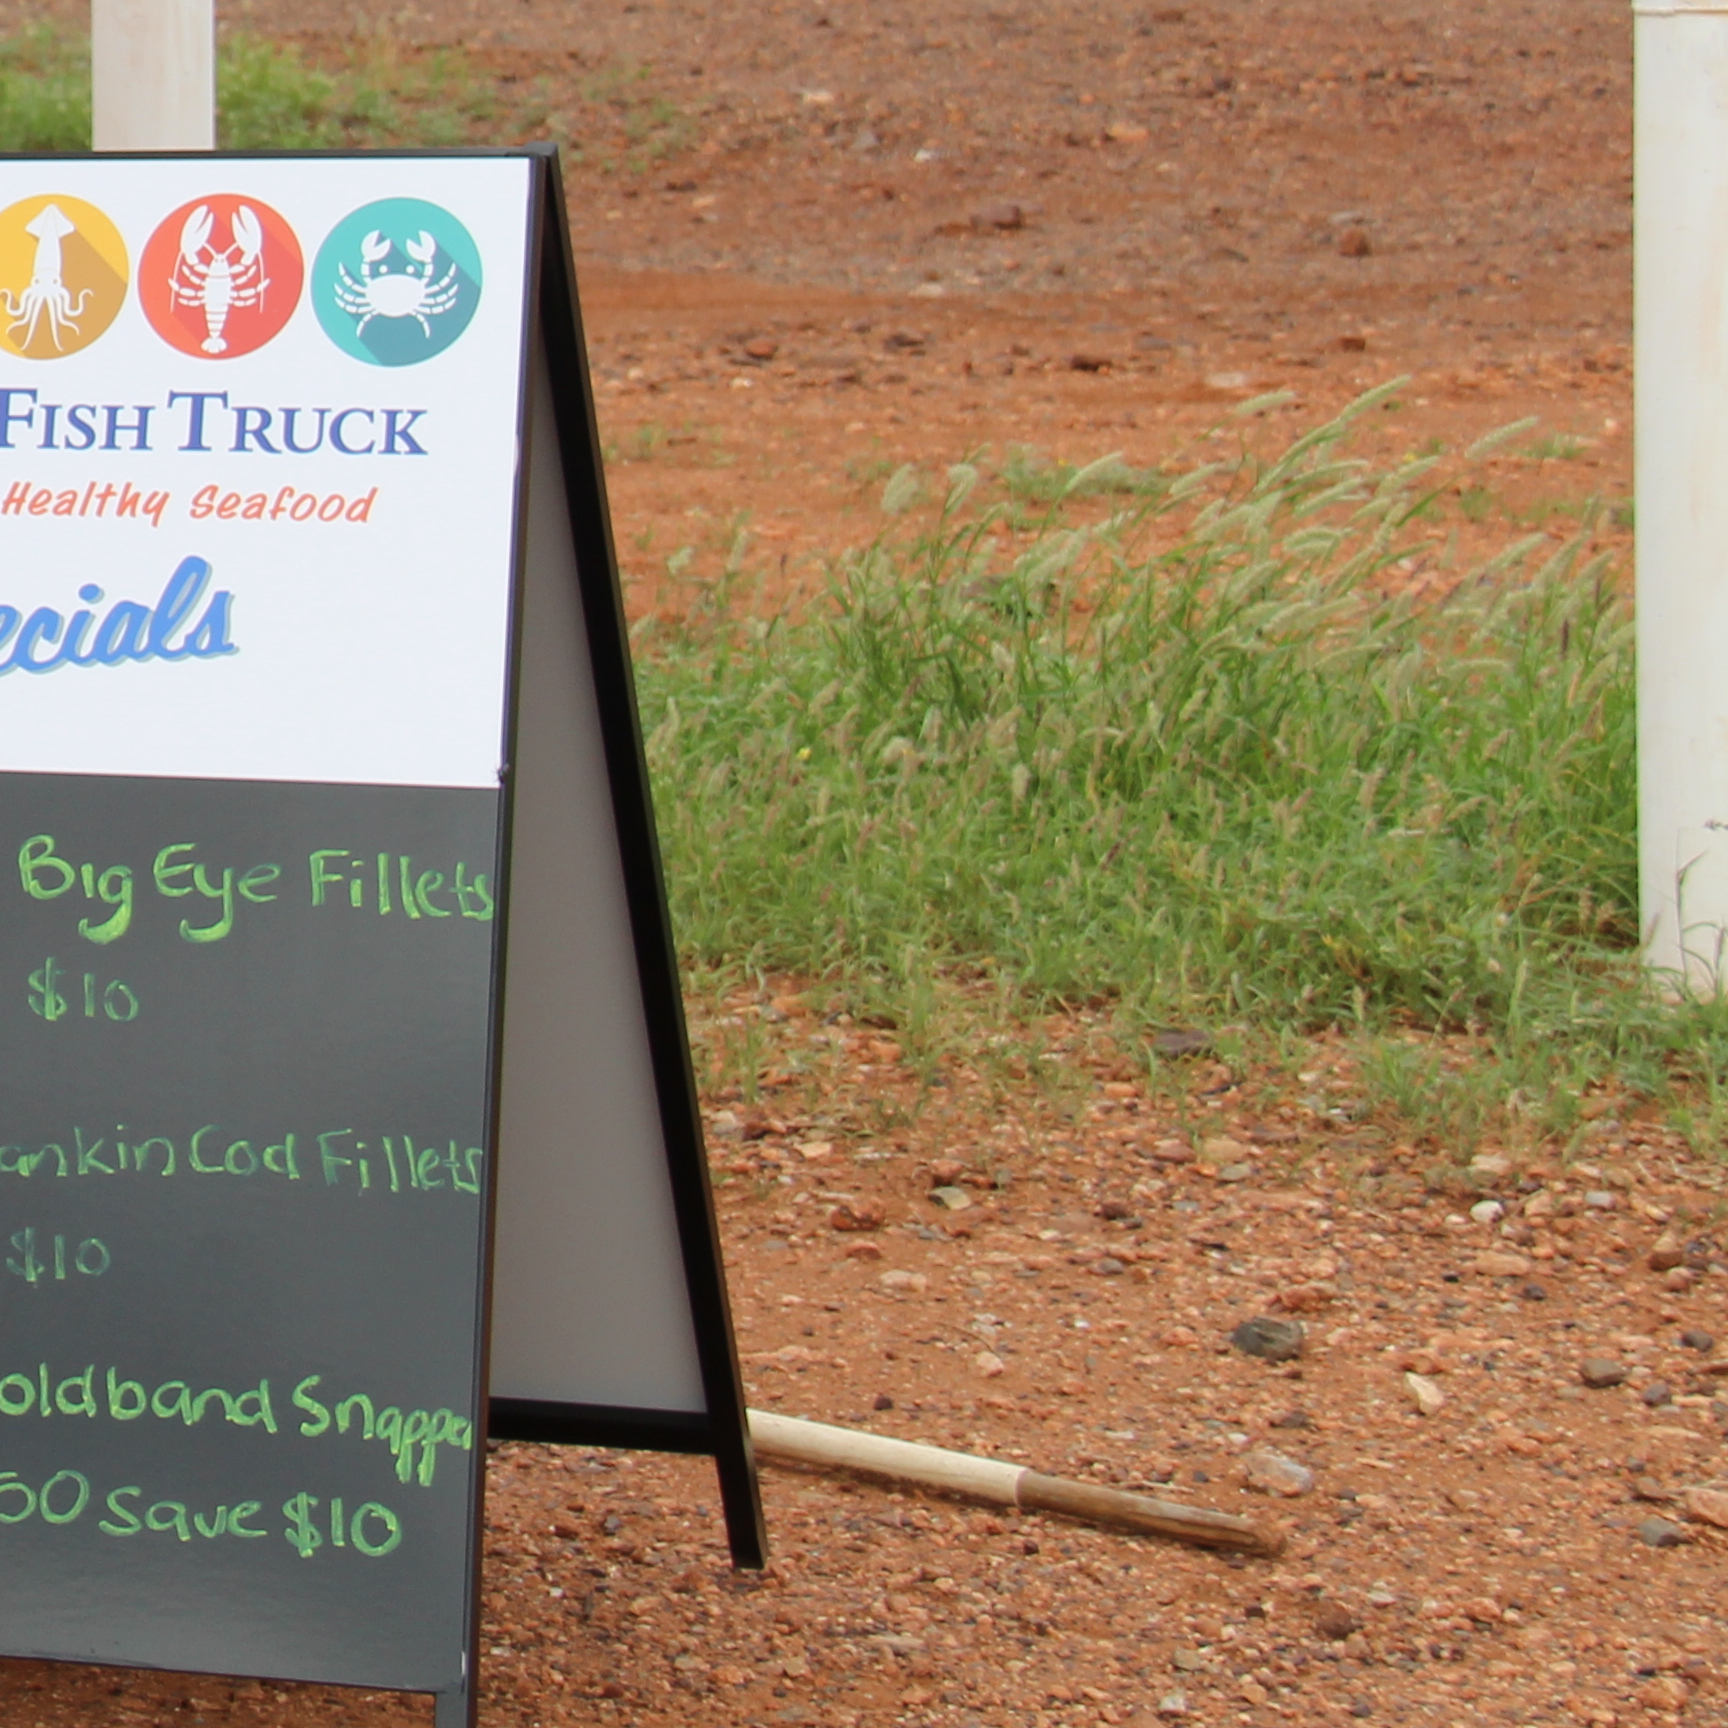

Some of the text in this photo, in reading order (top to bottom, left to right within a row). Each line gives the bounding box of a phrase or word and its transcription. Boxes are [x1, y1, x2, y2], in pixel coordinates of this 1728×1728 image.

[168, 391, 428, 457] TRUCK
[1, 481, 170, 527] Healthy
[190, 484, 378, 522] Seafood
[16, 834, 135, 945] Big
[151, 842, 282, 944] Eye
[308, 848, 496, 922] Fillets
[27, 957, 140, 1022] $10
[189, 1126, 302, 1180] Cod
[317, 1128, 482, 1194] Fillets
[8, 1228, 112, 1285] $10
[282, 1492, 403, 1558] $10
